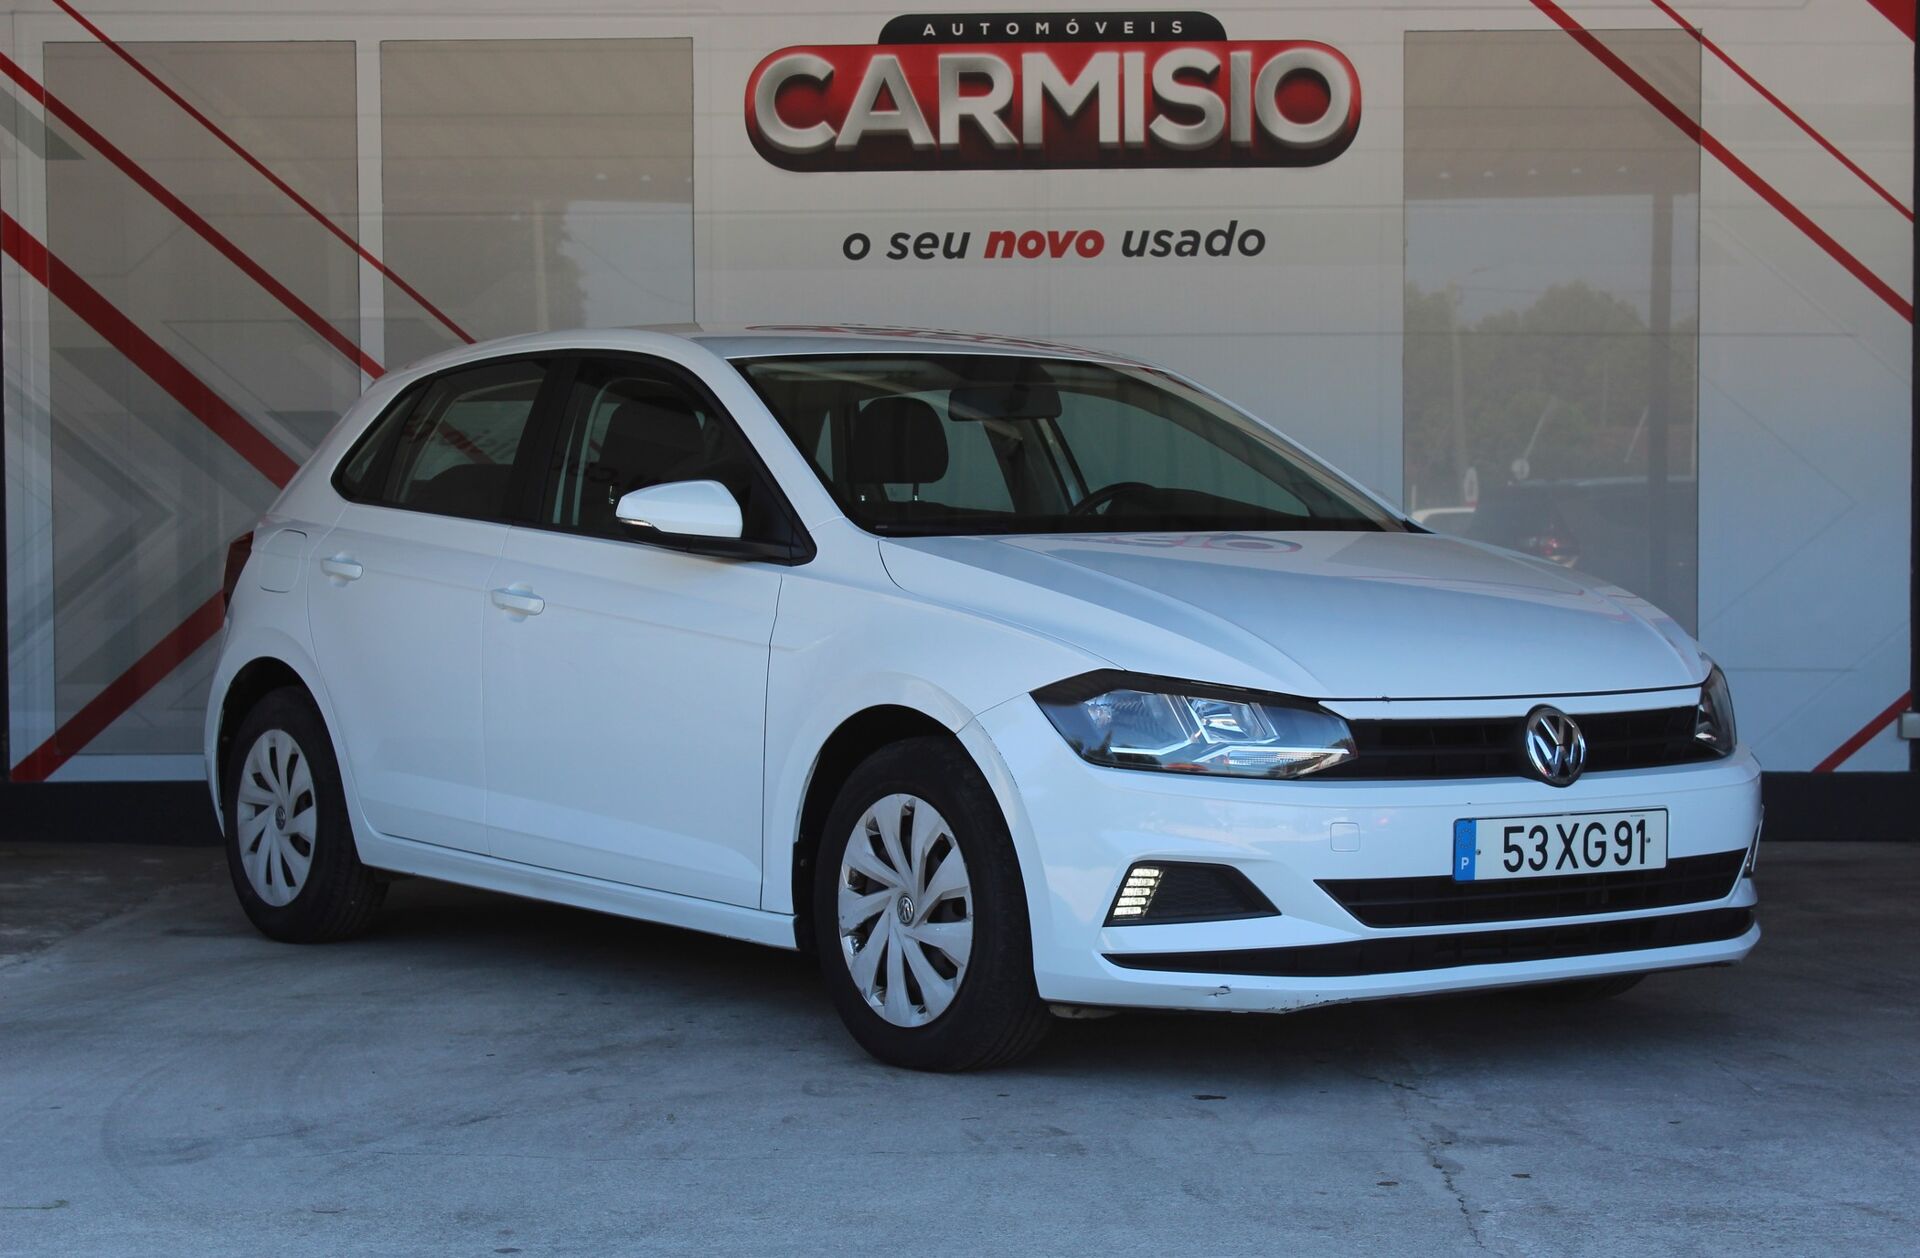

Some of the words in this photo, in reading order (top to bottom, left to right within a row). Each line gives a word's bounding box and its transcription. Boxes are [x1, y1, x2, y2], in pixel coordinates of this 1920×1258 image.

[922, 19, 1186, 38] AUTOMÓVEIS
[754, 48, 1352, 155] CARMISIO
[842, 233, 871, 261] o
[886, 231, 970, 260] seu
[984, 230, 1105, 260] novo
[1121, 220, 1267, 258] usado
[1461, 857, 1470, 870] P
[1503, 819, 1646, 873] 53XG91
